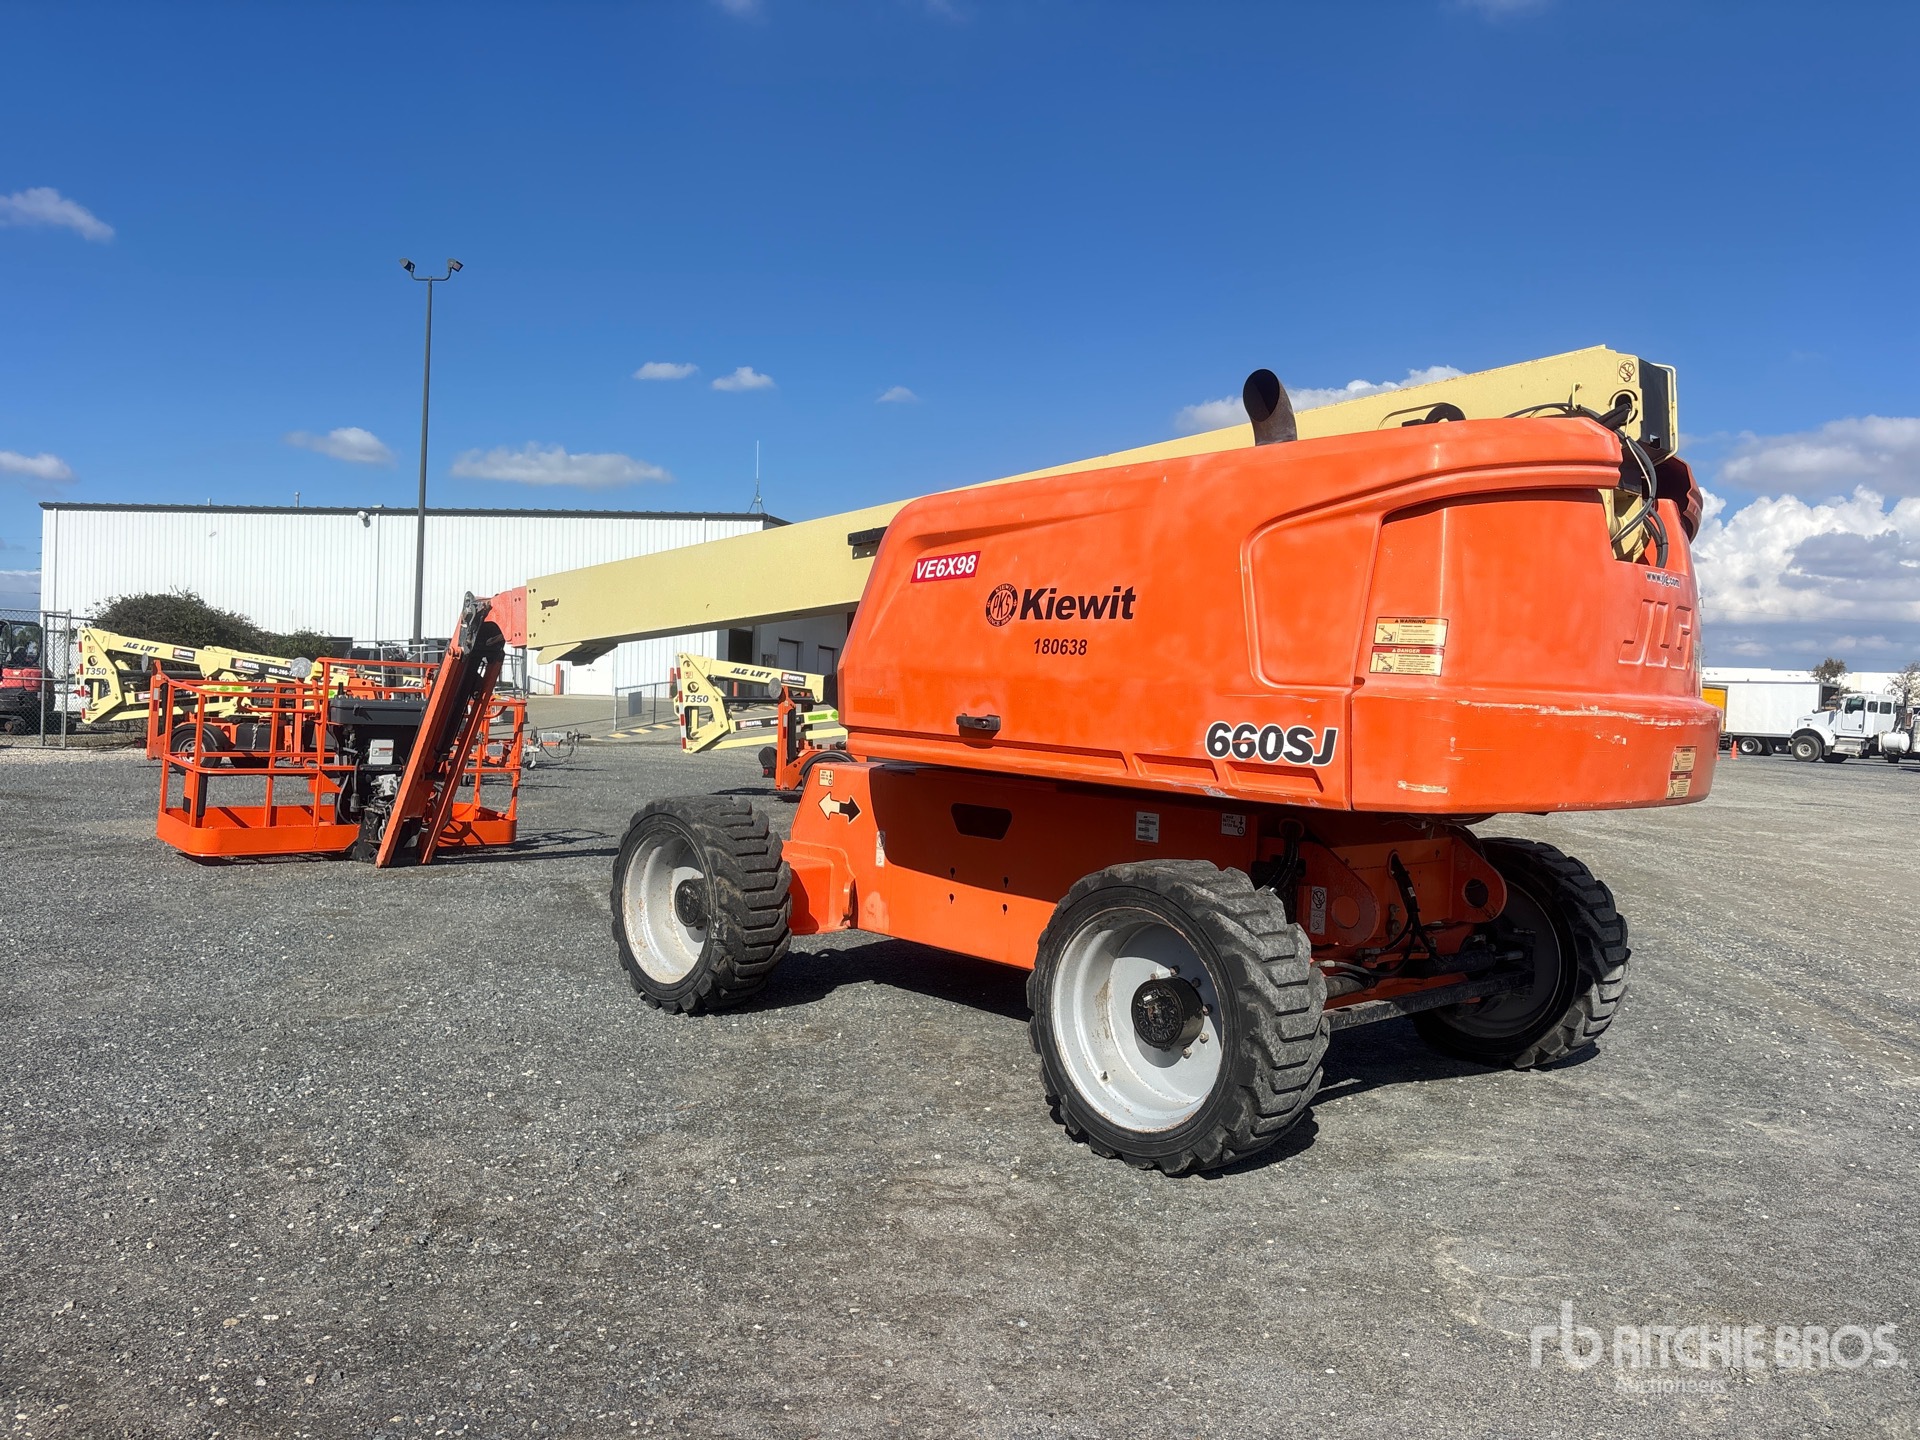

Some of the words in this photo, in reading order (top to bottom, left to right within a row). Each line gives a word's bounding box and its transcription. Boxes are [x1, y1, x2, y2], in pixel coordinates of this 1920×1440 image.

[916, 554, 976, 579] VE6X98
[1020, 586, 1136, 620] Kiewit
[123, 642, 139, 650] JLG
[140, 644, 159, 653] LIFT
[1034, 638, 1088, 655] 180638
[86, 667, 107, 675] T350
[730, 667, 749, 675] JLG
[750, 670, 771, 678] LIFT
[685, 695, 709, 703] T350
[1205, 721, 1338, 766] 660SJ
